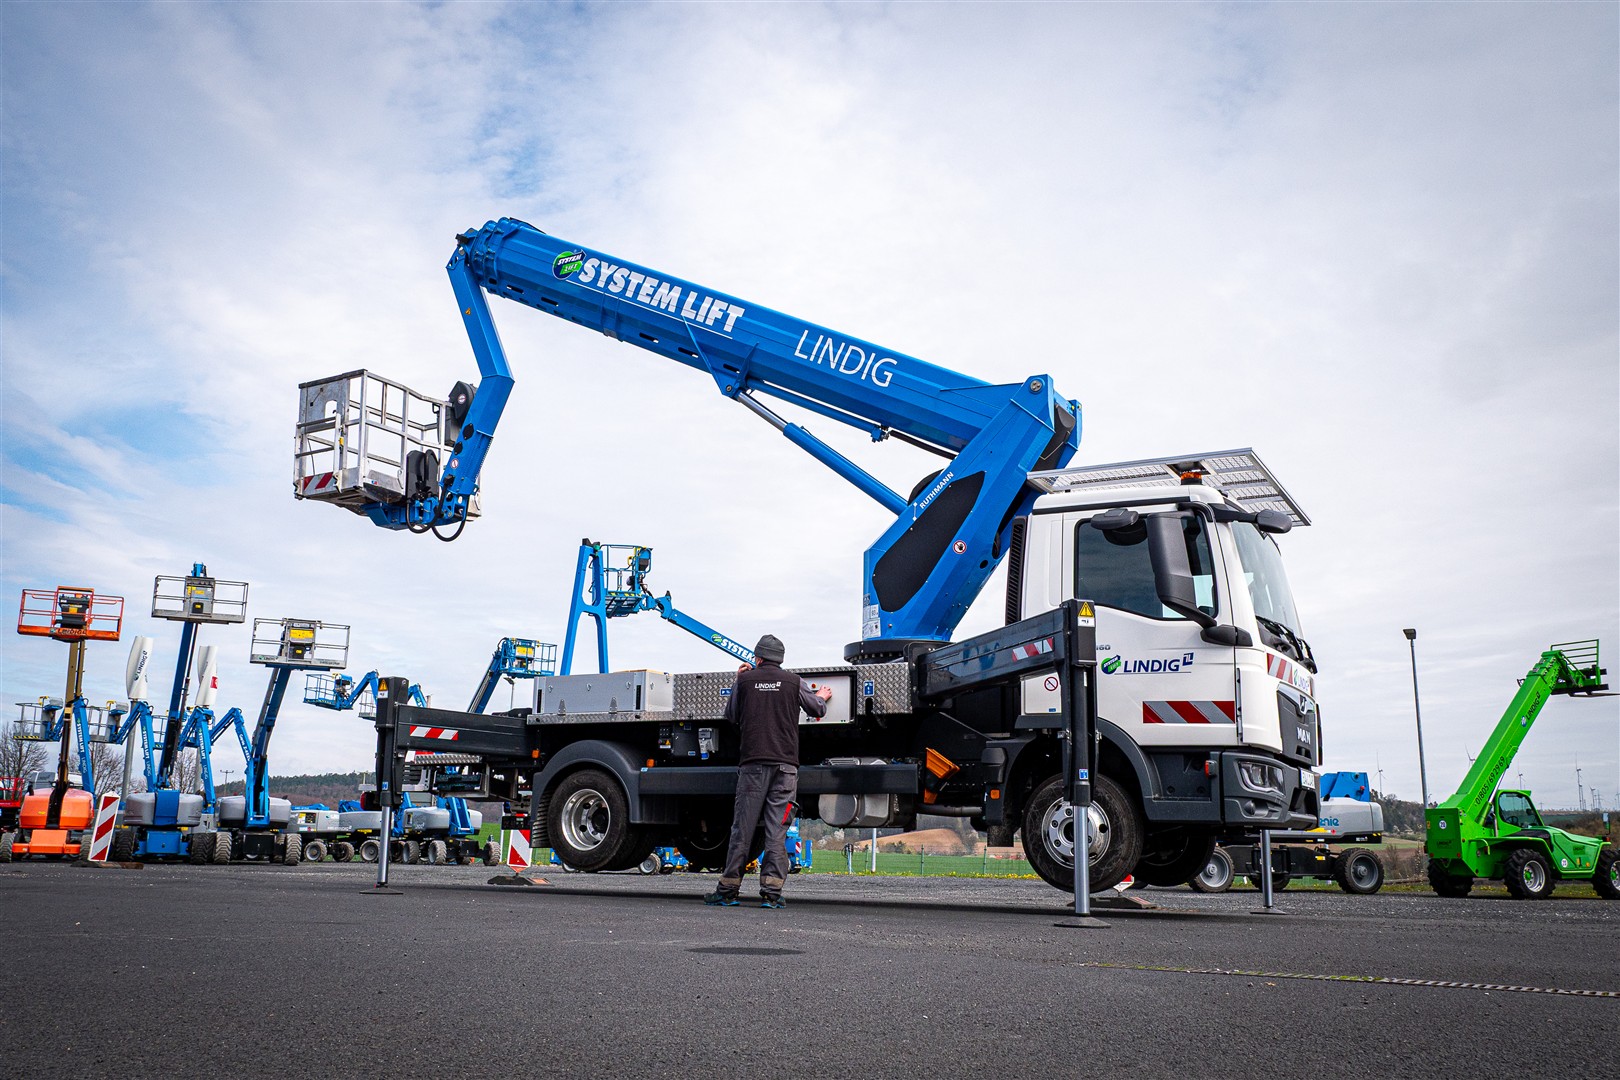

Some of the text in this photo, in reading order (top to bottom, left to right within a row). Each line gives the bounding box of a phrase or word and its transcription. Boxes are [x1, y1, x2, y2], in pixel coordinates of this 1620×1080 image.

[557, 253, 582, 265] SYSTEM
[579, 257, 745, 333] SYSTEM LIFT
[794, 329, 898, 388] LINDIG
[919, 471, 954, 509] RUTHMANN
[1123, 659, 1180, 673] LINDIG
[1525, 697, 1540, 720] LINDIG
[1297, 726, 1311, 745] MAN
[1319, 816, 1340, 826] enie
